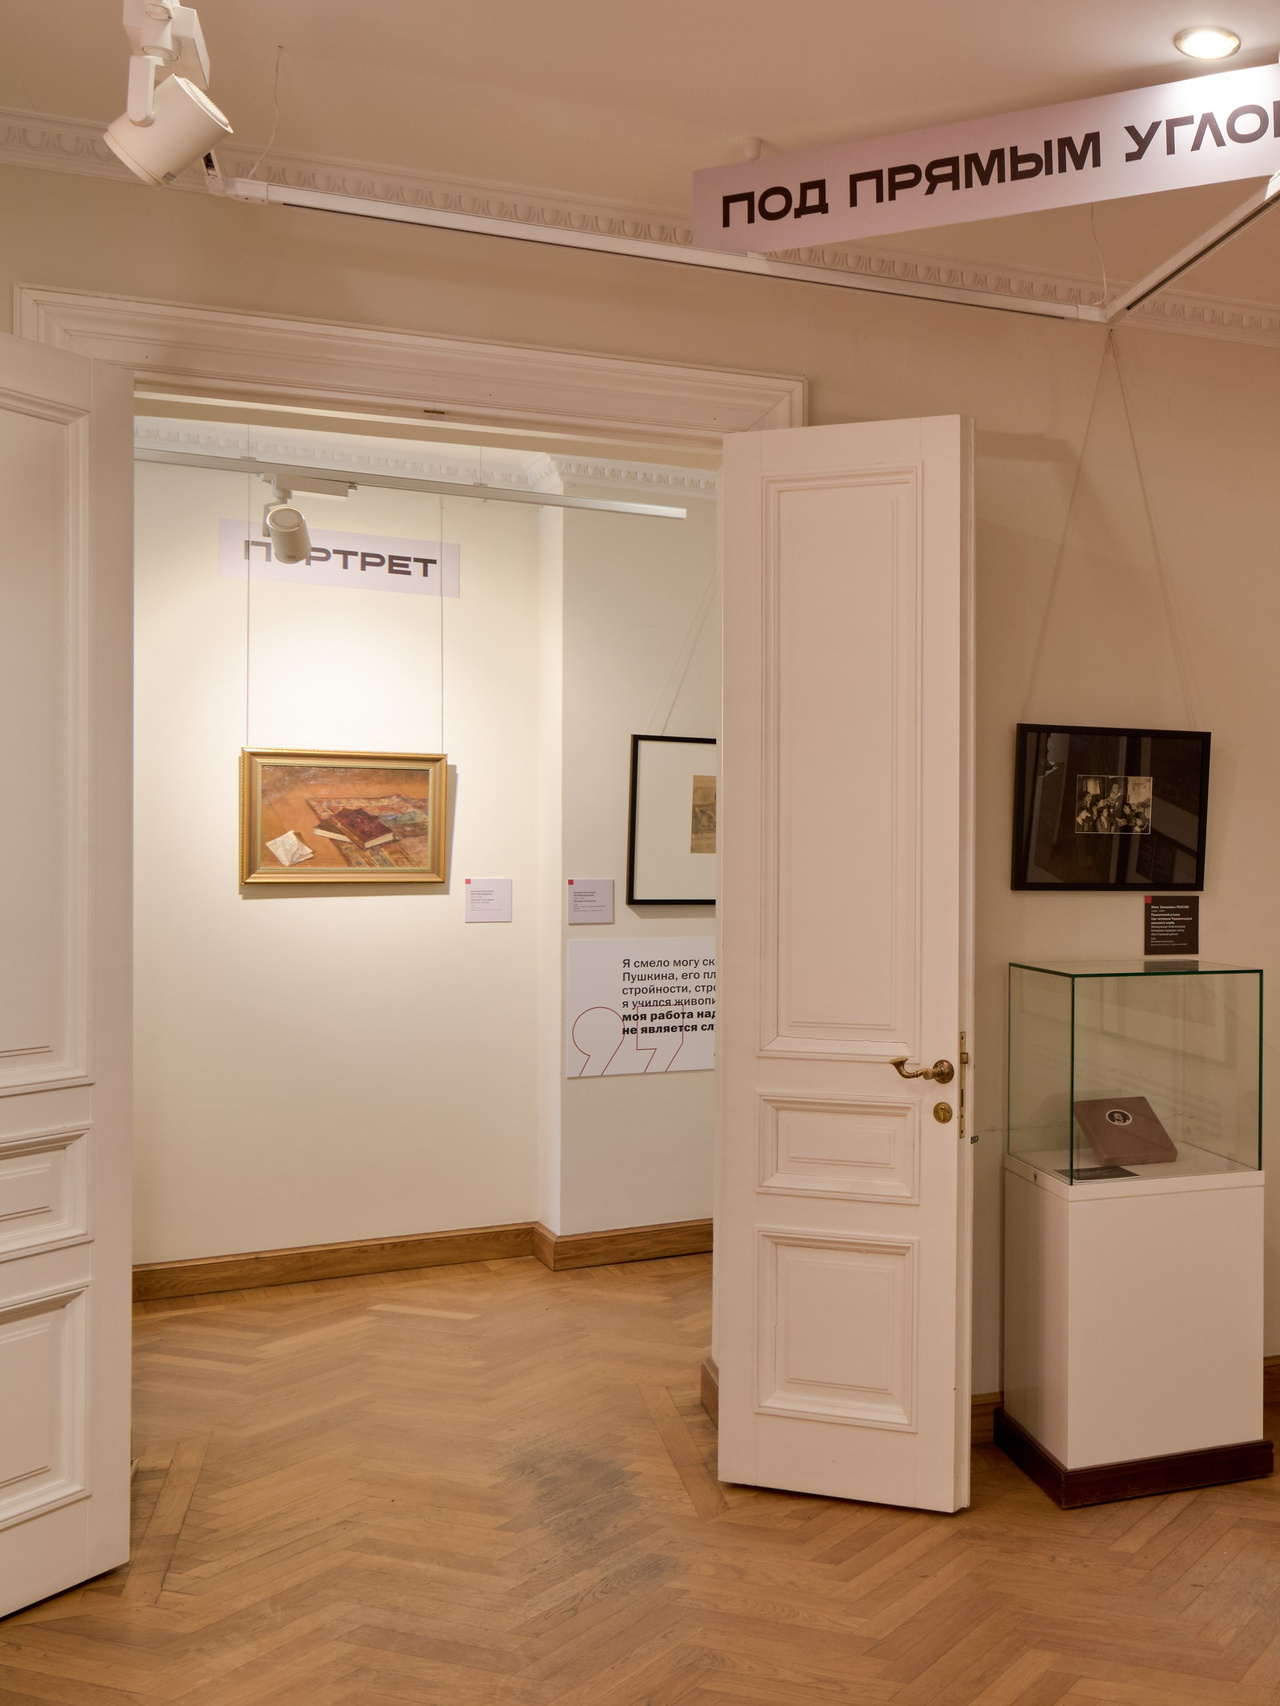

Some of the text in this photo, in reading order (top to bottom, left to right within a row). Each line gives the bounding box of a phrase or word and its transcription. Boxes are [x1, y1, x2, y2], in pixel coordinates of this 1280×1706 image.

[721, 180, 829, 228] ПОД
[848, 131, 1101, 209] ПРЯМЫМ
[244, 539, 437, 577] ПРТРЕТ
[621, 958, 630, 968] Я
[633, 959, 670, 967] смело
[672, 958, 699, 968] могу
[621, 971, 678, 983] Пушкина,
[681, 971, 700, 980] его
[621, 984, 691, 996] стройности,
[621, 1000, 628, 1008] я
[631, 998, 671, 1009] учился
[621, 1012, 646, 1021] моя
[650, 1009, 693, 1022] работа
[621, 1026, 637, 1035] не
[640, 1023, 697, 1034] является
